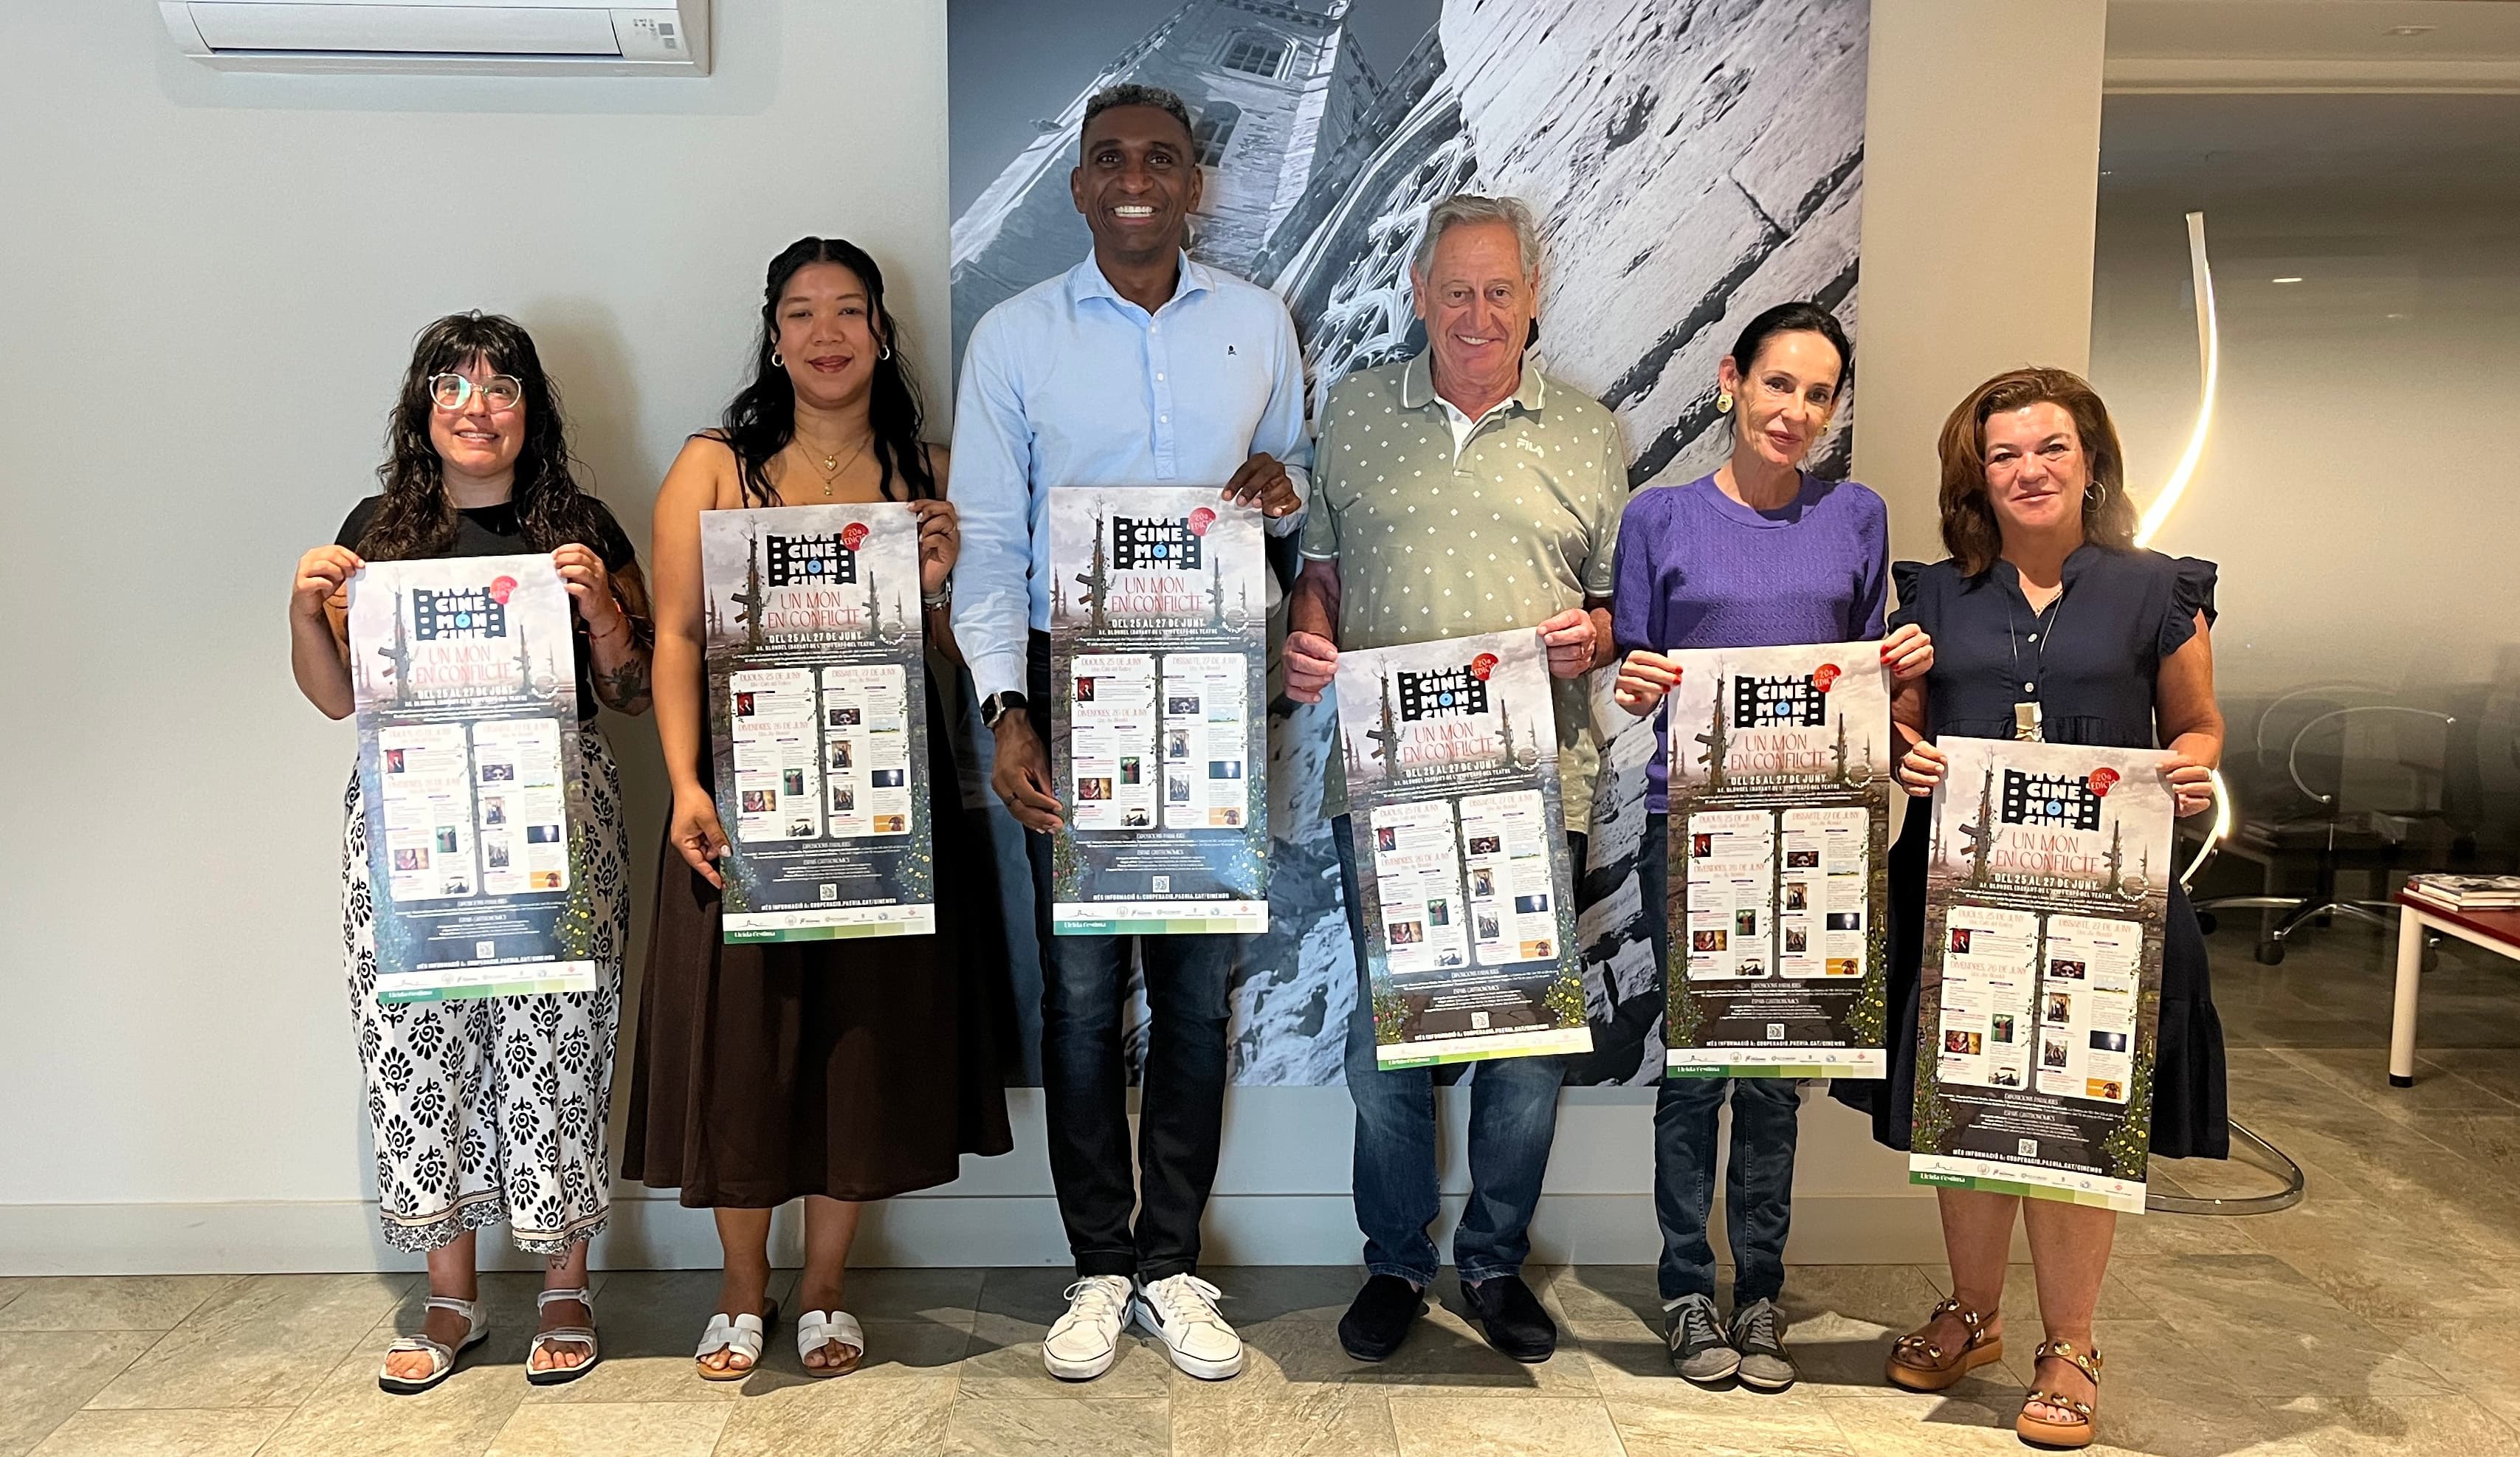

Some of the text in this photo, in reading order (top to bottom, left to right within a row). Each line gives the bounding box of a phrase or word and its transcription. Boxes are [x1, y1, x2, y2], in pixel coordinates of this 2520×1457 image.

[1134, 527, 1182, 541] CINE
[788, 543, 836, 558] CINE
[1125, 576, 1146, 593] UN
[435, 598, 485, 614] CINE
[780, 593, 802, 610] UN
[1112, 593, 1203, 612] EN CONFLICTE
[768, 607, 860, 628] EN CONFLICTE
[1112, 618, 1205, 627] DEL 25 AL 27 DE JUNY
[769, 631, 862, 644] DEL 25 AL 27 DE JUNY
[1418, 675, 1467, 694] CINE
[1755, 685, 1805, 700] CINE
[418, 689, 435, 700] DEL
[436, 689, 448, 699] 25
[450, 688, 462, 698] AL
[464, 687, 475, 698] 27
[476, 687, 488, 697] DE
[1414, 726, 1436, 744] UN
[1745, 734, 1766, 751] UN
[1403, 737, 1495, 763] EN CONFLICTE
[1405, 768, 1422, 778] DEL
[1423, 765, 1435, 776] 25
[1436, 765, 1448, 774] AL
[1449, 763, 1460, 774] 27
[1461, 762, 1473, 772] DE
[1473, 759, 1497, 771] JUNY
[1731, 749, 1826, 771] EN CONFLICTE
[1731, 774, 1826, 785] DEL 25 AL 27 DE JUNY
[2025, 782, 2080, 800] CINE
[2011, 830, 2035, 850] UN
[1995, 849, 2099, 875] EN CONFLICTE
[1994, 872, 2013, 883] DEL
[2014, 873, 2027, 884] 25
[2028, 875, 2042, 886] AL
[2043, 876, 2056, 887] 27
[2057, 878, 2070, 889] DE
[2071, 879, 2098, 891] JUNY
